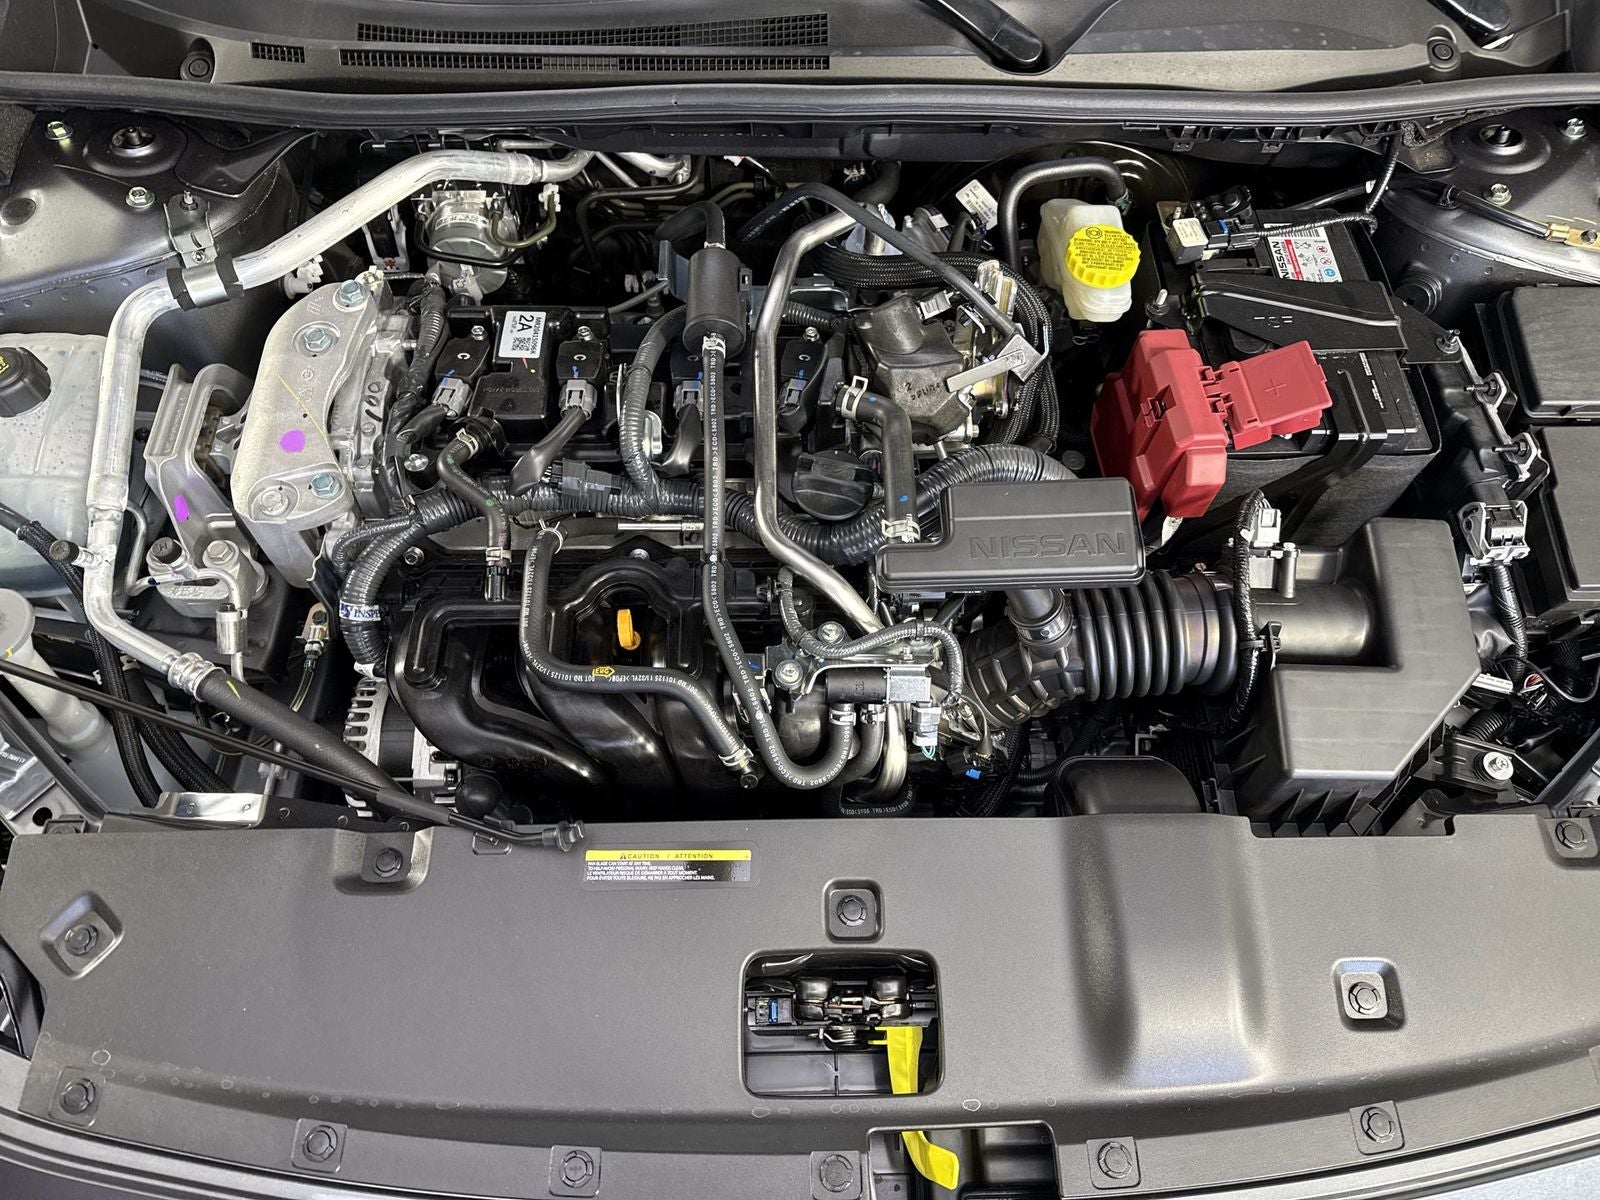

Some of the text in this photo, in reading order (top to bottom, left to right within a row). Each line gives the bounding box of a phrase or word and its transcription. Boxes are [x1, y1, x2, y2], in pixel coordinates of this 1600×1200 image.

[1272, 241, 1290, 279] NISSAN
[517, 315, 534, 332] 2A
[969, 531, 1126, 560] NISSAN
